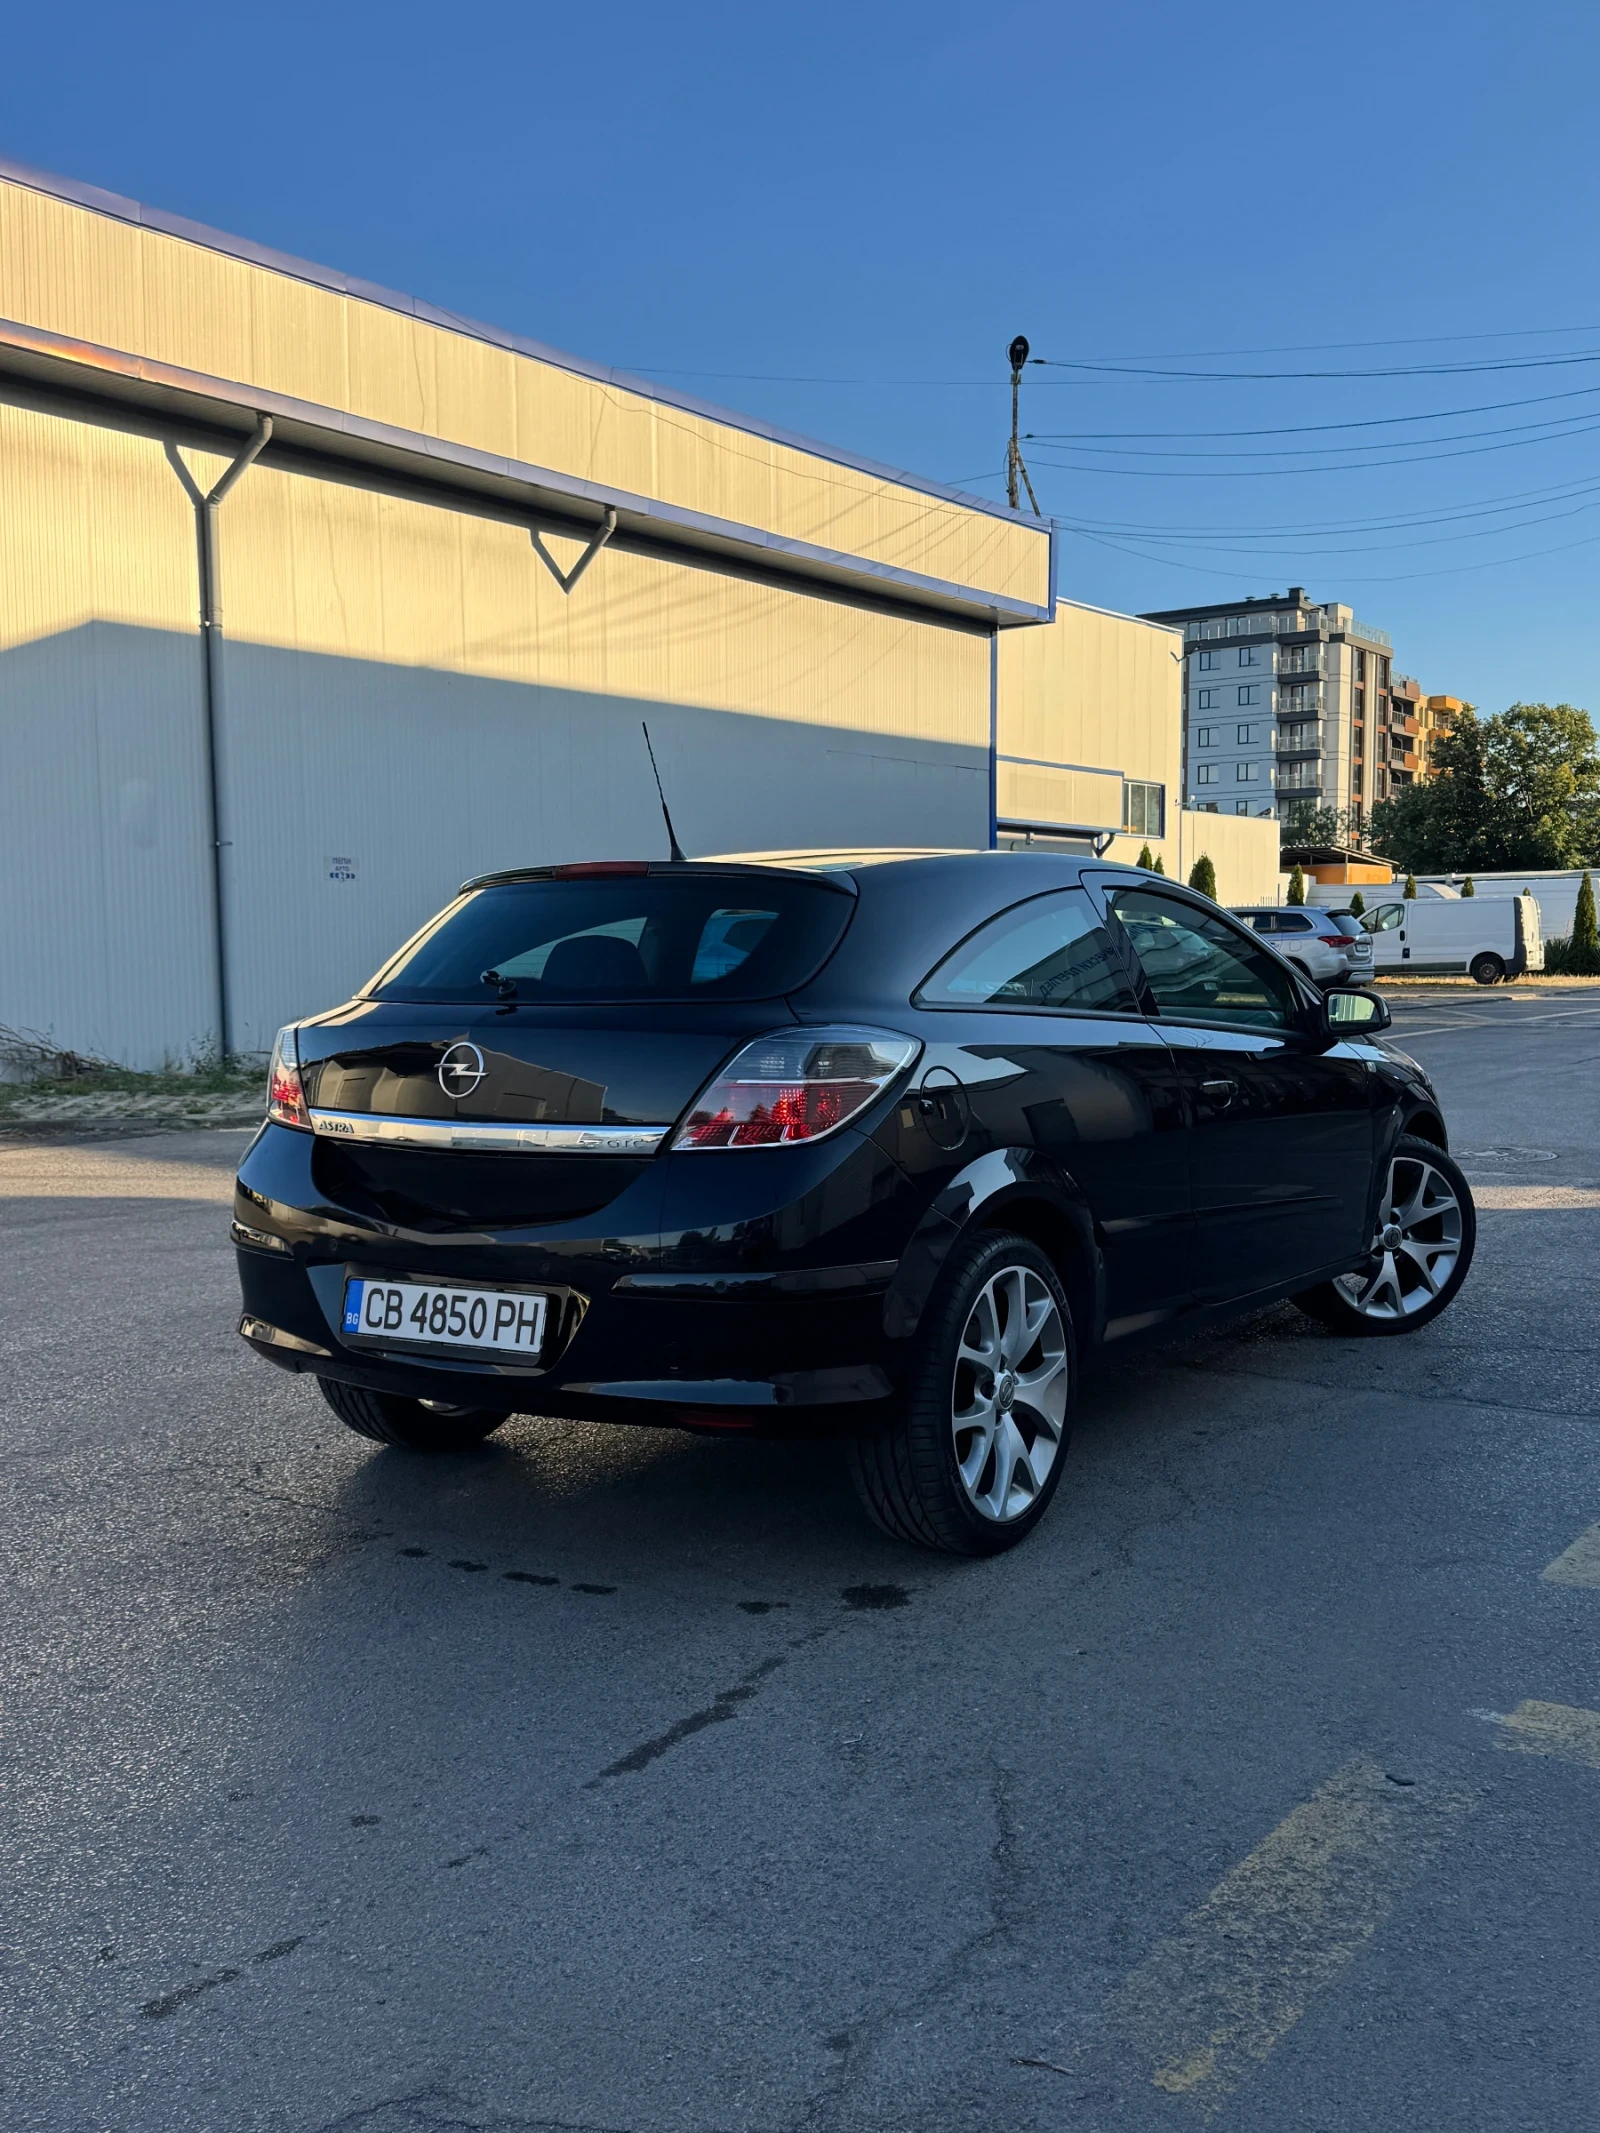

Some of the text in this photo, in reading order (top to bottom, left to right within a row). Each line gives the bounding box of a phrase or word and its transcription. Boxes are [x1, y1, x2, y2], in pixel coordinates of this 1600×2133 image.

[319, 1120, 355, 1134] ASTRA
[606, 1138, 645, 1149] GTC
[346, 1312, 359, 1325] BG
[365, 1288, 540, 1345] CB 4850 PH
